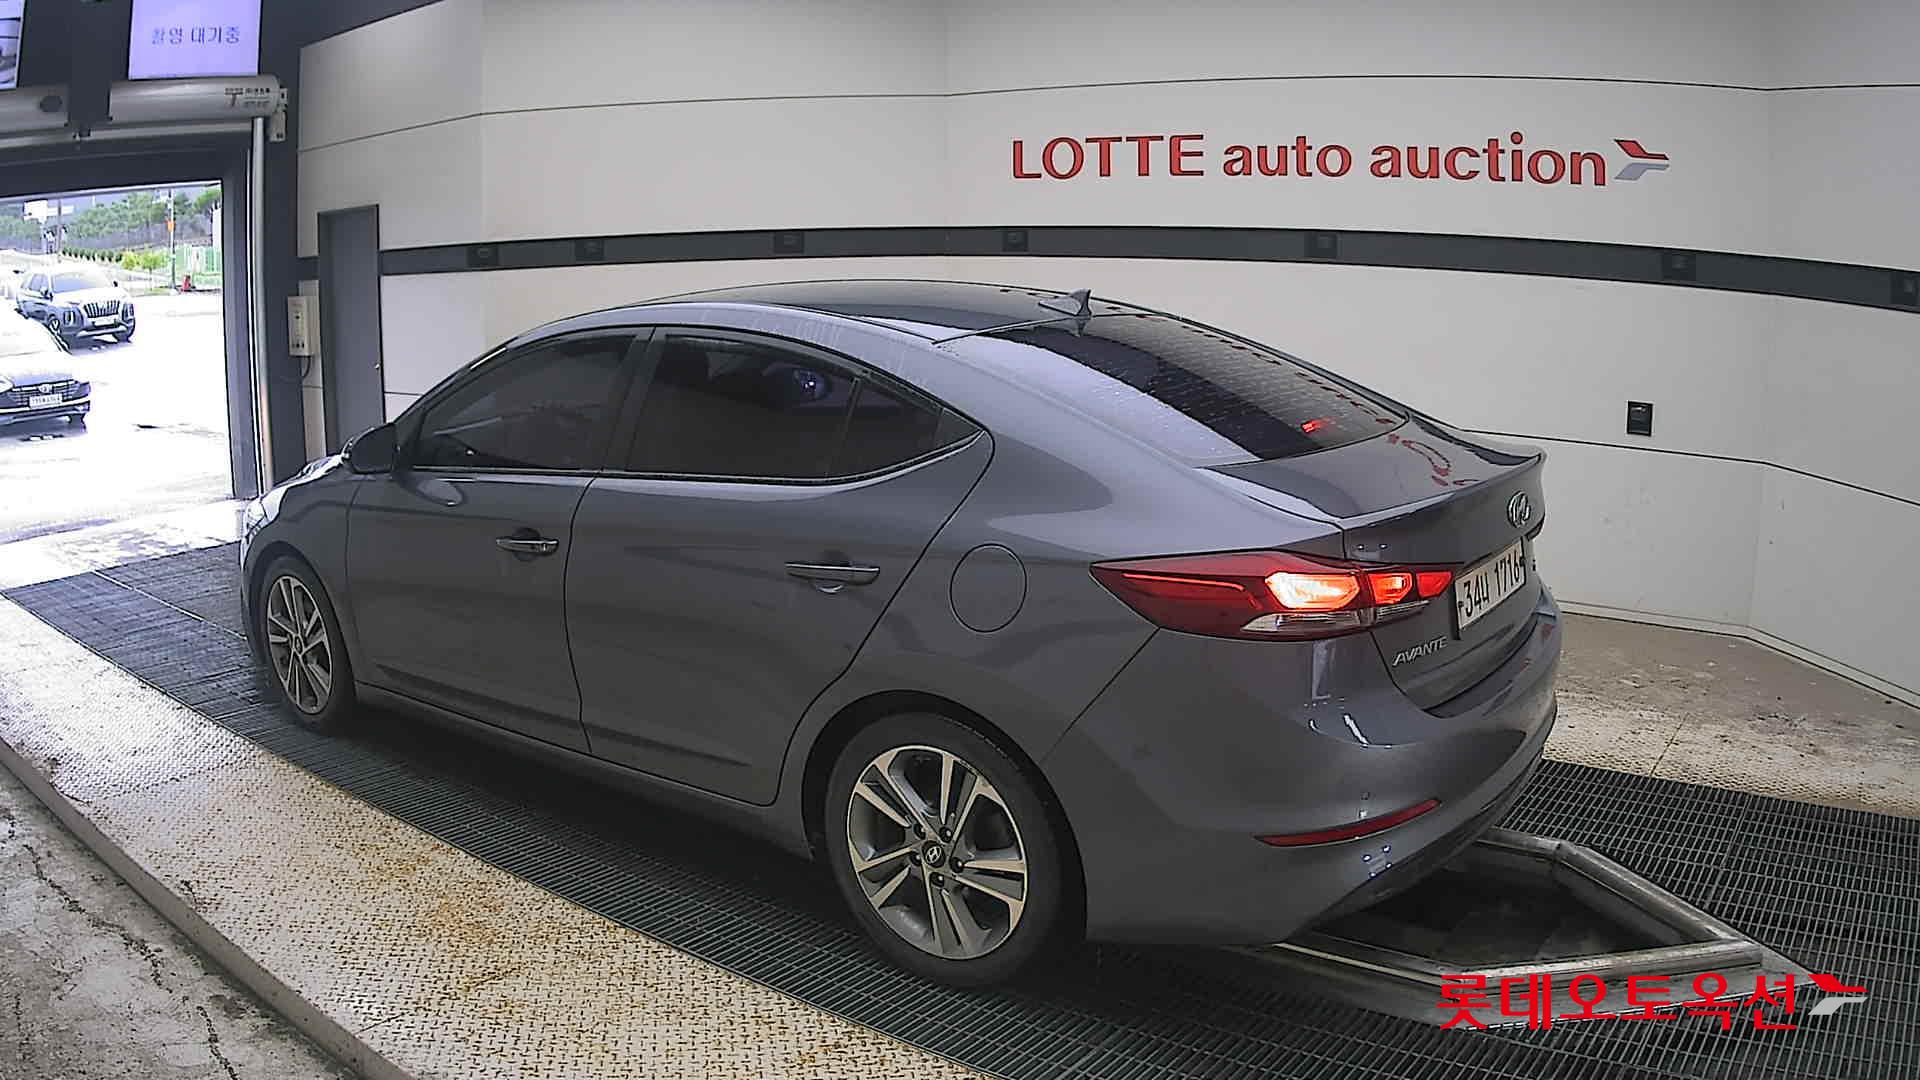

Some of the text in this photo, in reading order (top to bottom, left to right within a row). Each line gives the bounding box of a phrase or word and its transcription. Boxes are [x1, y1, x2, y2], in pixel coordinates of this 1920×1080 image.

[1012, 131, 1606, 186] LOTTE auto auction
[1494, 550, 1519, 597] 1716
[1392, 636, 1447, 666] AVANTE
